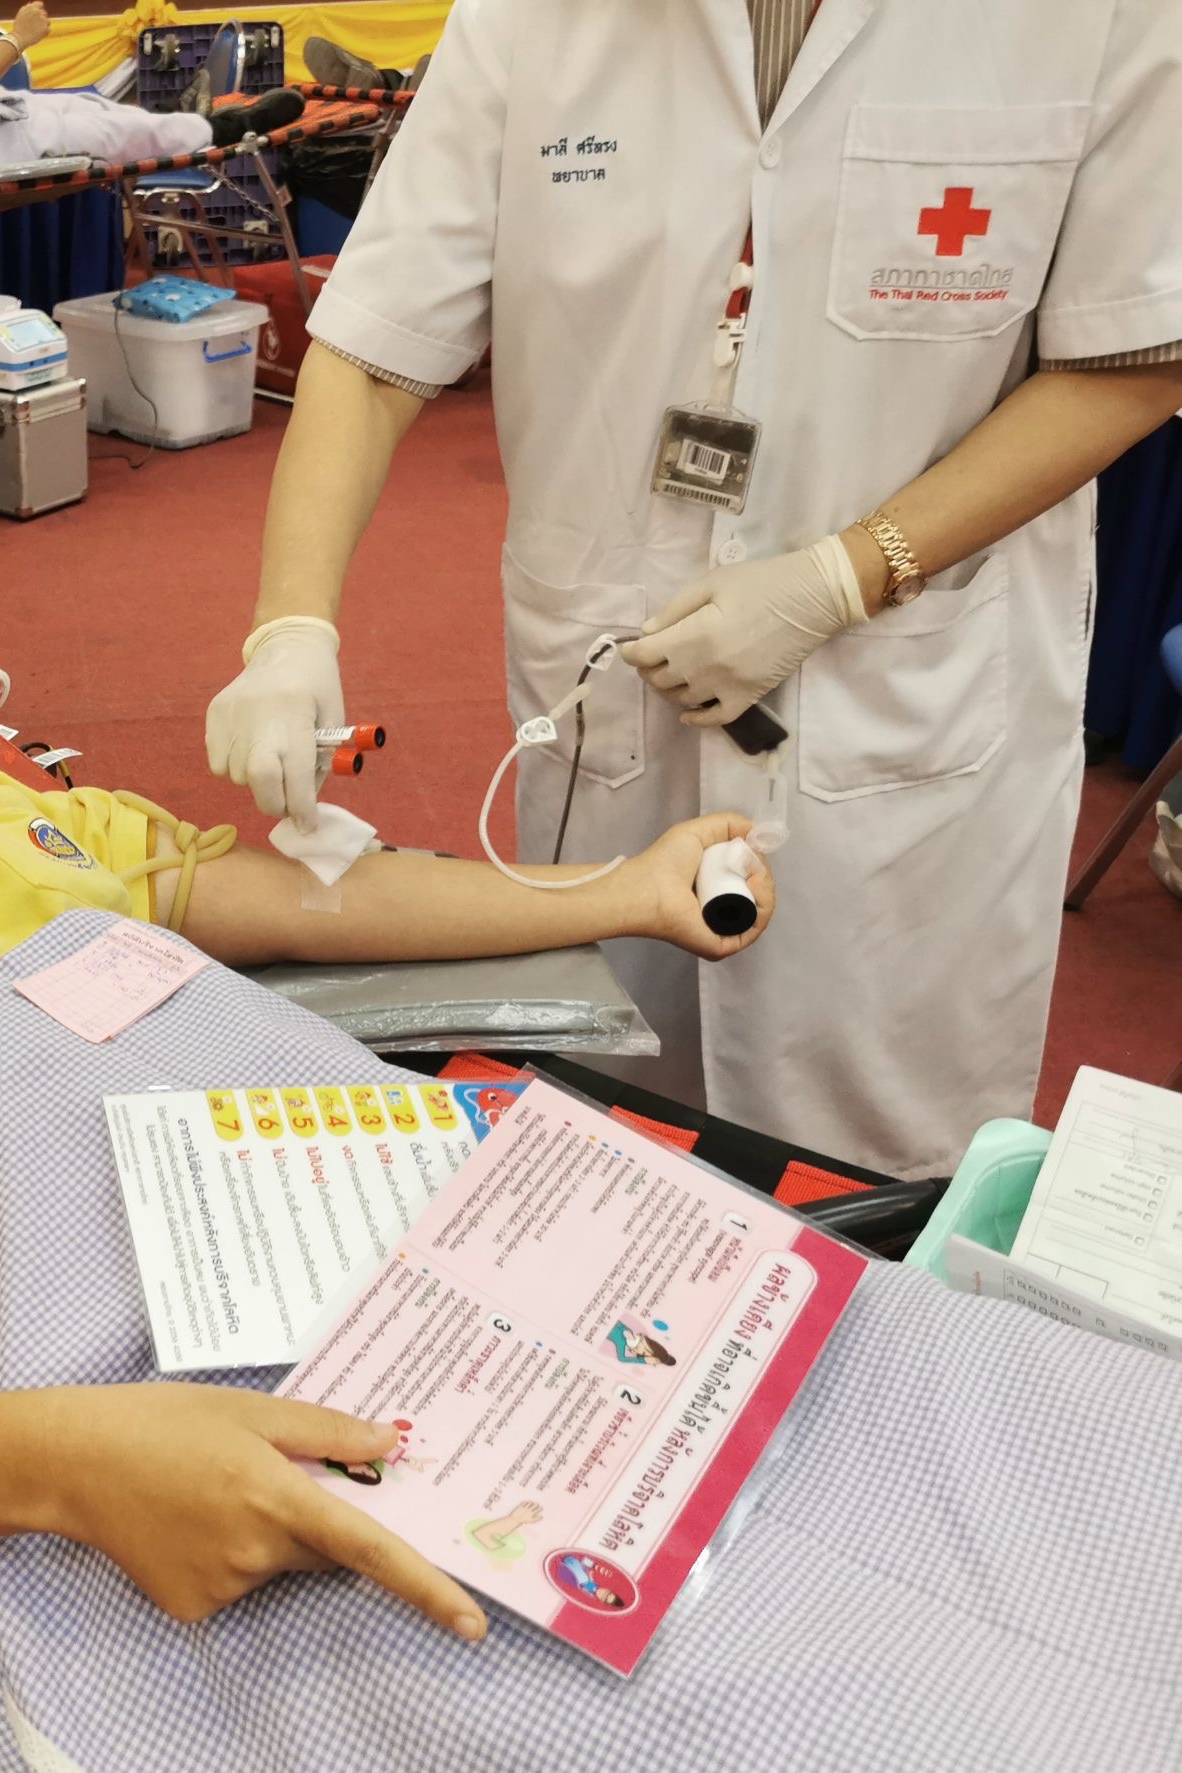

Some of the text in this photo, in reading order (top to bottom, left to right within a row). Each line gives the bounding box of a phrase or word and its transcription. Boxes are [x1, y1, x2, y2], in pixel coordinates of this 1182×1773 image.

[540, 136, 568, 157] มาลี
[551, 167, 606, 183] พยาบาล
[871, 263, 1014, 286] สภากาชาดไทย
[869, 289, 1009, 301] The Thai Red Cross Society
[216, 1119, 240, 1131] 7
[257, 1117, 277, 1130] 6
[292, 1117, 313, 1128] 5
[327, 1114, 347, 1127] 4
[360, 1114, 381, 1125] 3
[393, 1113, 415, 1124] 2
[178, 1118, 239, 1333] อาการไม่พึงประสงค์หลังการบริจาคโลหิต
[729, 1219, 747, 1230] 1
[493, 1318, 511, 1332] 3
[620, 1389, 641, 1405] 2
[600, 1263, 790, 1550] ผลข้างเคียง ที่อาจเกิดขึ้นได้ หลังการบริจาคโลหิต
